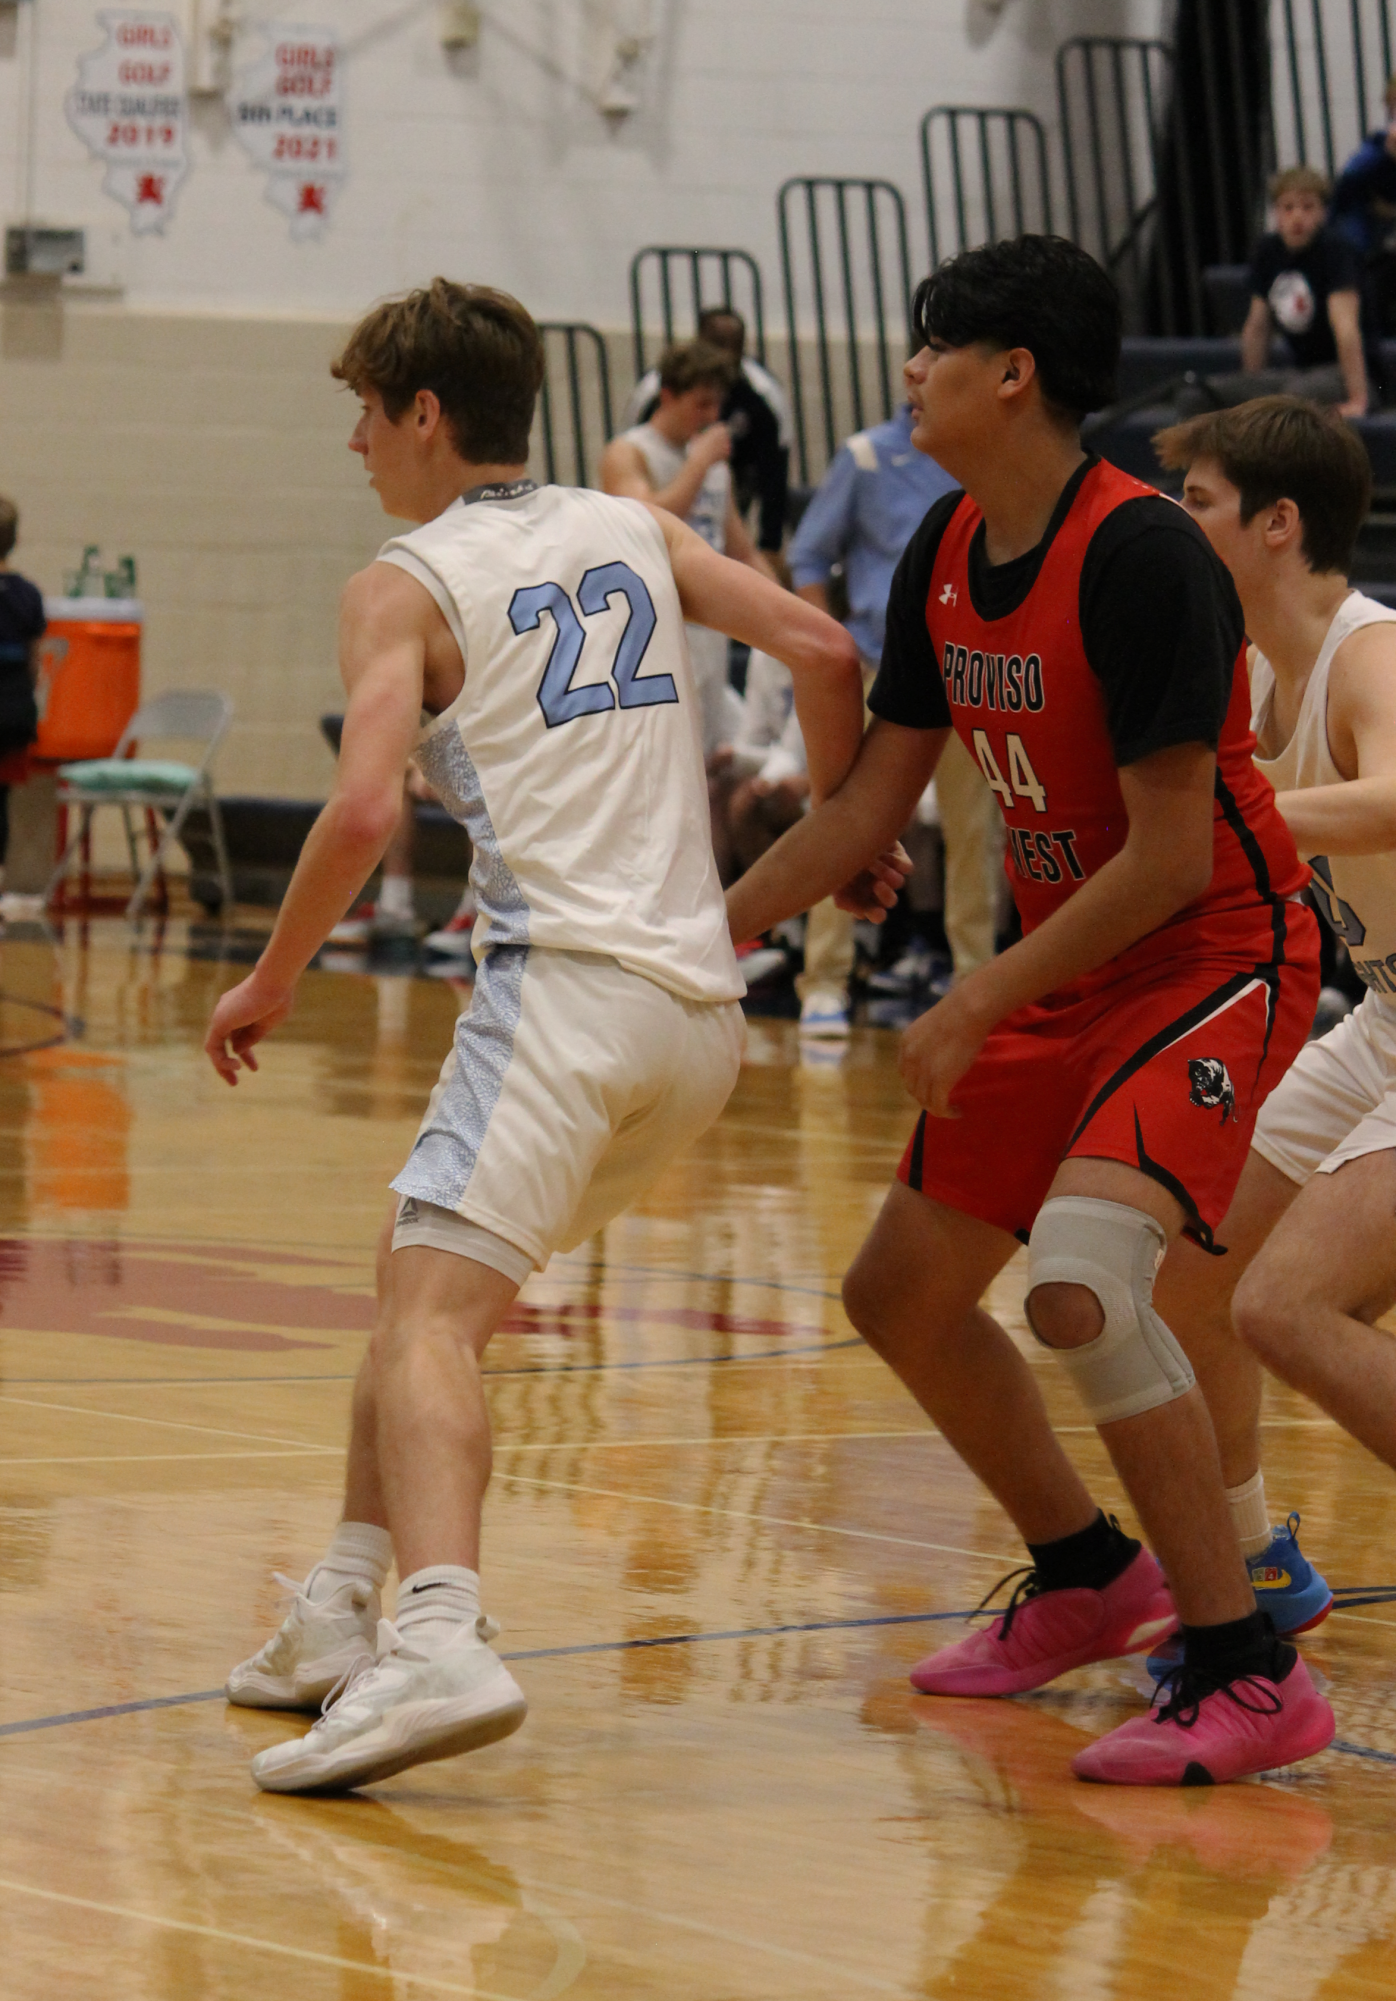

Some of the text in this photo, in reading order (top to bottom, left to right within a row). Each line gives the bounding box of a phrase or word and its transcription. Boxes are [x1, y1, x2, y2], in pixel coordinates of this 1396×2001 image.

[116, 24, 173, 50] GIRLS
[276, 43, 336, 71] GIRLS
[118, 60, 172, 86] GOLF
[276, 71, 333, 98] GOLF
[106, 122, 176, 148] 2019
[272, 134, 338, 161] 2021
[508, 561, 679, 729] 22
[943, 641, 1045, 713] PROVISO
[972, 727, 1048, 813] 44
